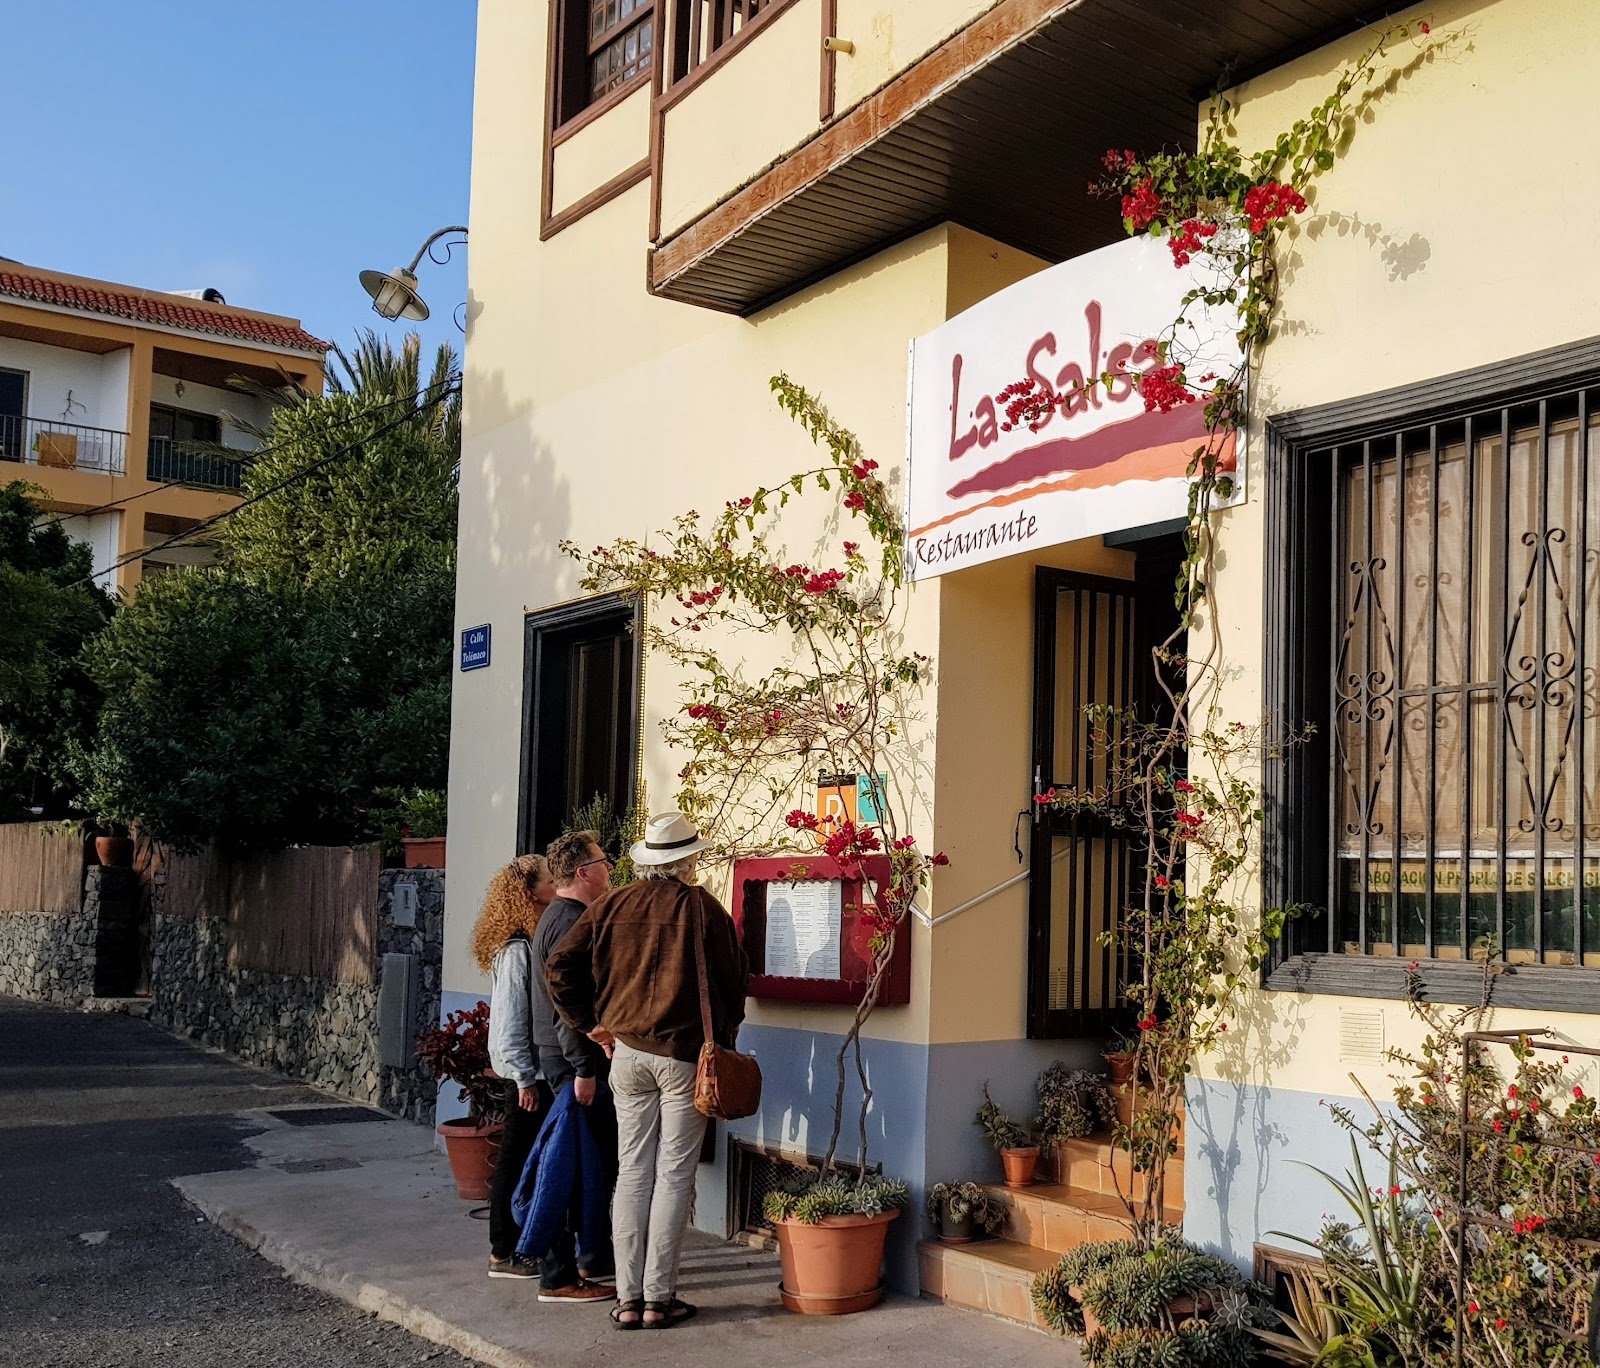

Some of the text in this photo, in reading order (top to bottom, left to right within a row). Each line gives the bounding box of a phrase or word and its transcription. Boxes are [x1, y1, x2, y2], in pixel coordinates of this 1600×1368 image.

[949, 299, 1168, 462] La Salsa
[912, 509, 1039, 575] Restaurante
[470, 631, 484, 645] Calle
